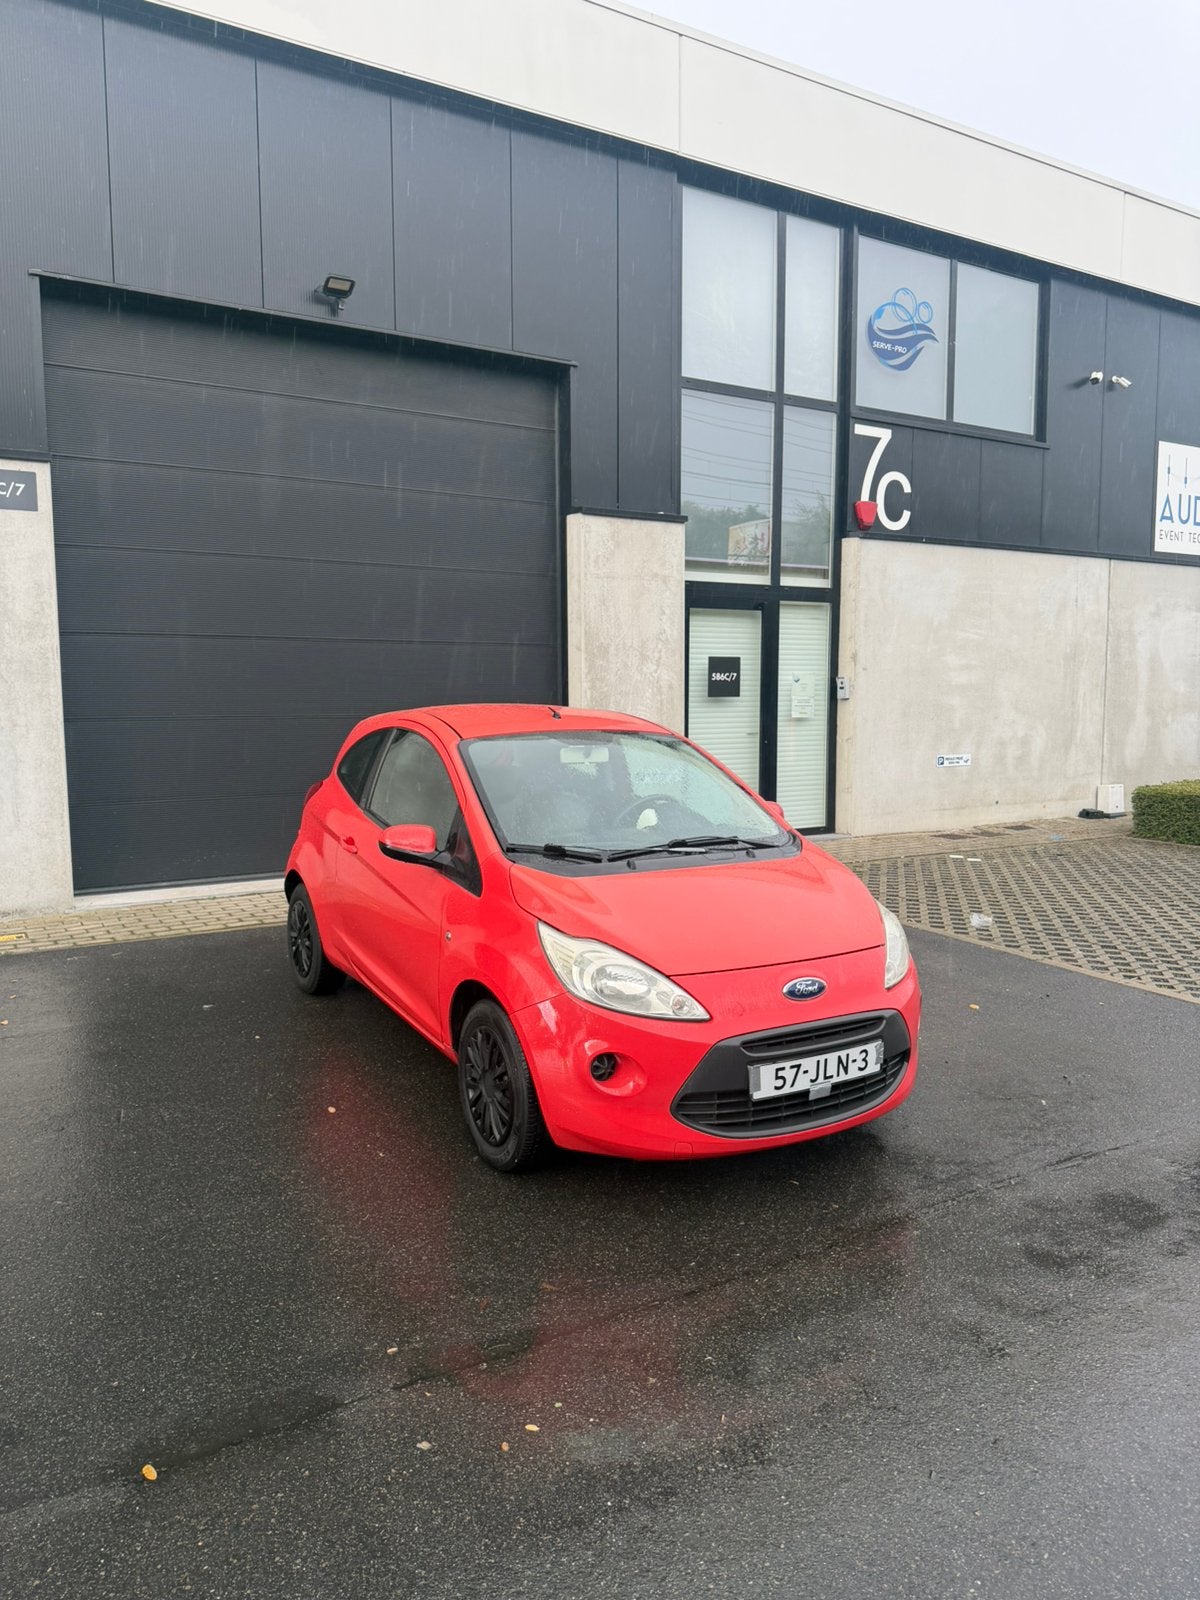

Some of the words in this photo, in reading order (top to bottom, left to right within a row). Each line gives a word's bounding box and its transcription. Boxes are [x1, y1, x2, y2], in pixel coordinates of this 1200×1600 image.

[872, 340, 907, 354] SERVE-PRO
[1159, 529, 1184, 542] EVENT
[711, 671, 737, 682] 586C/7
[795, 980, 818, 995] Ford
[773, 1048, 869, 1091] 57-JLN-3
